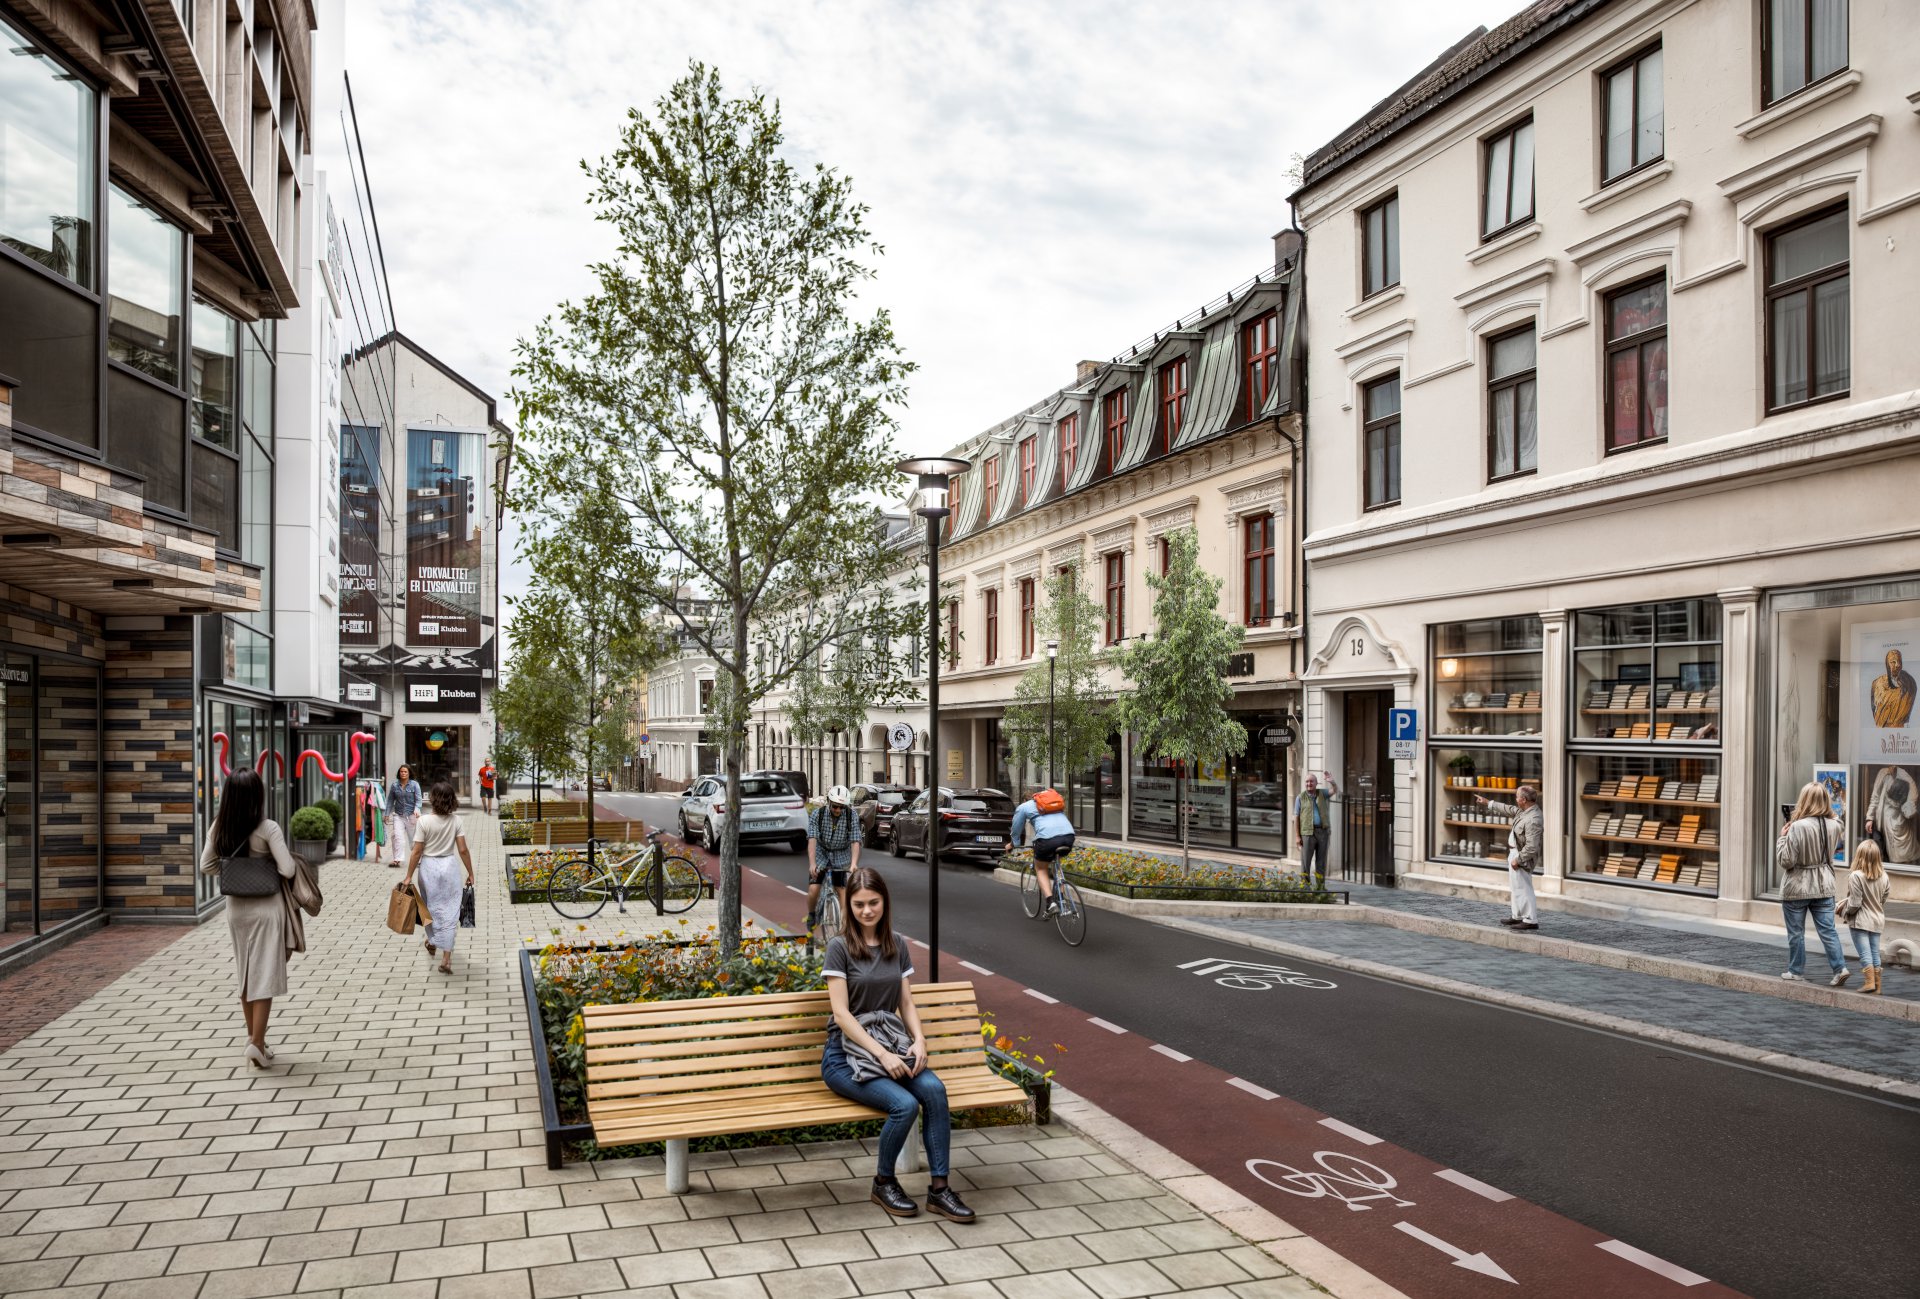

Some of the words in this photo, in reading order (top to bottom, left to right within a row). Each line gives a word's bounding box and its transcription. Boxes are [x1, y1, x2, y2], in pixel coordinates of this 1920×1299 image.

[418, 566, 469, 580] LYDKVALITET
[410, 580, 420, 592] ER
[422, 580, 477, 594] LIVSKVALITET
[440, 625, 467, 633] Klubben
[1351, 638, 1364, 656] 19
[414, 689, 434, 697] HiFi
[440, 689, 476, 698] Klubben
[1396, 712, 1411, 738] P
